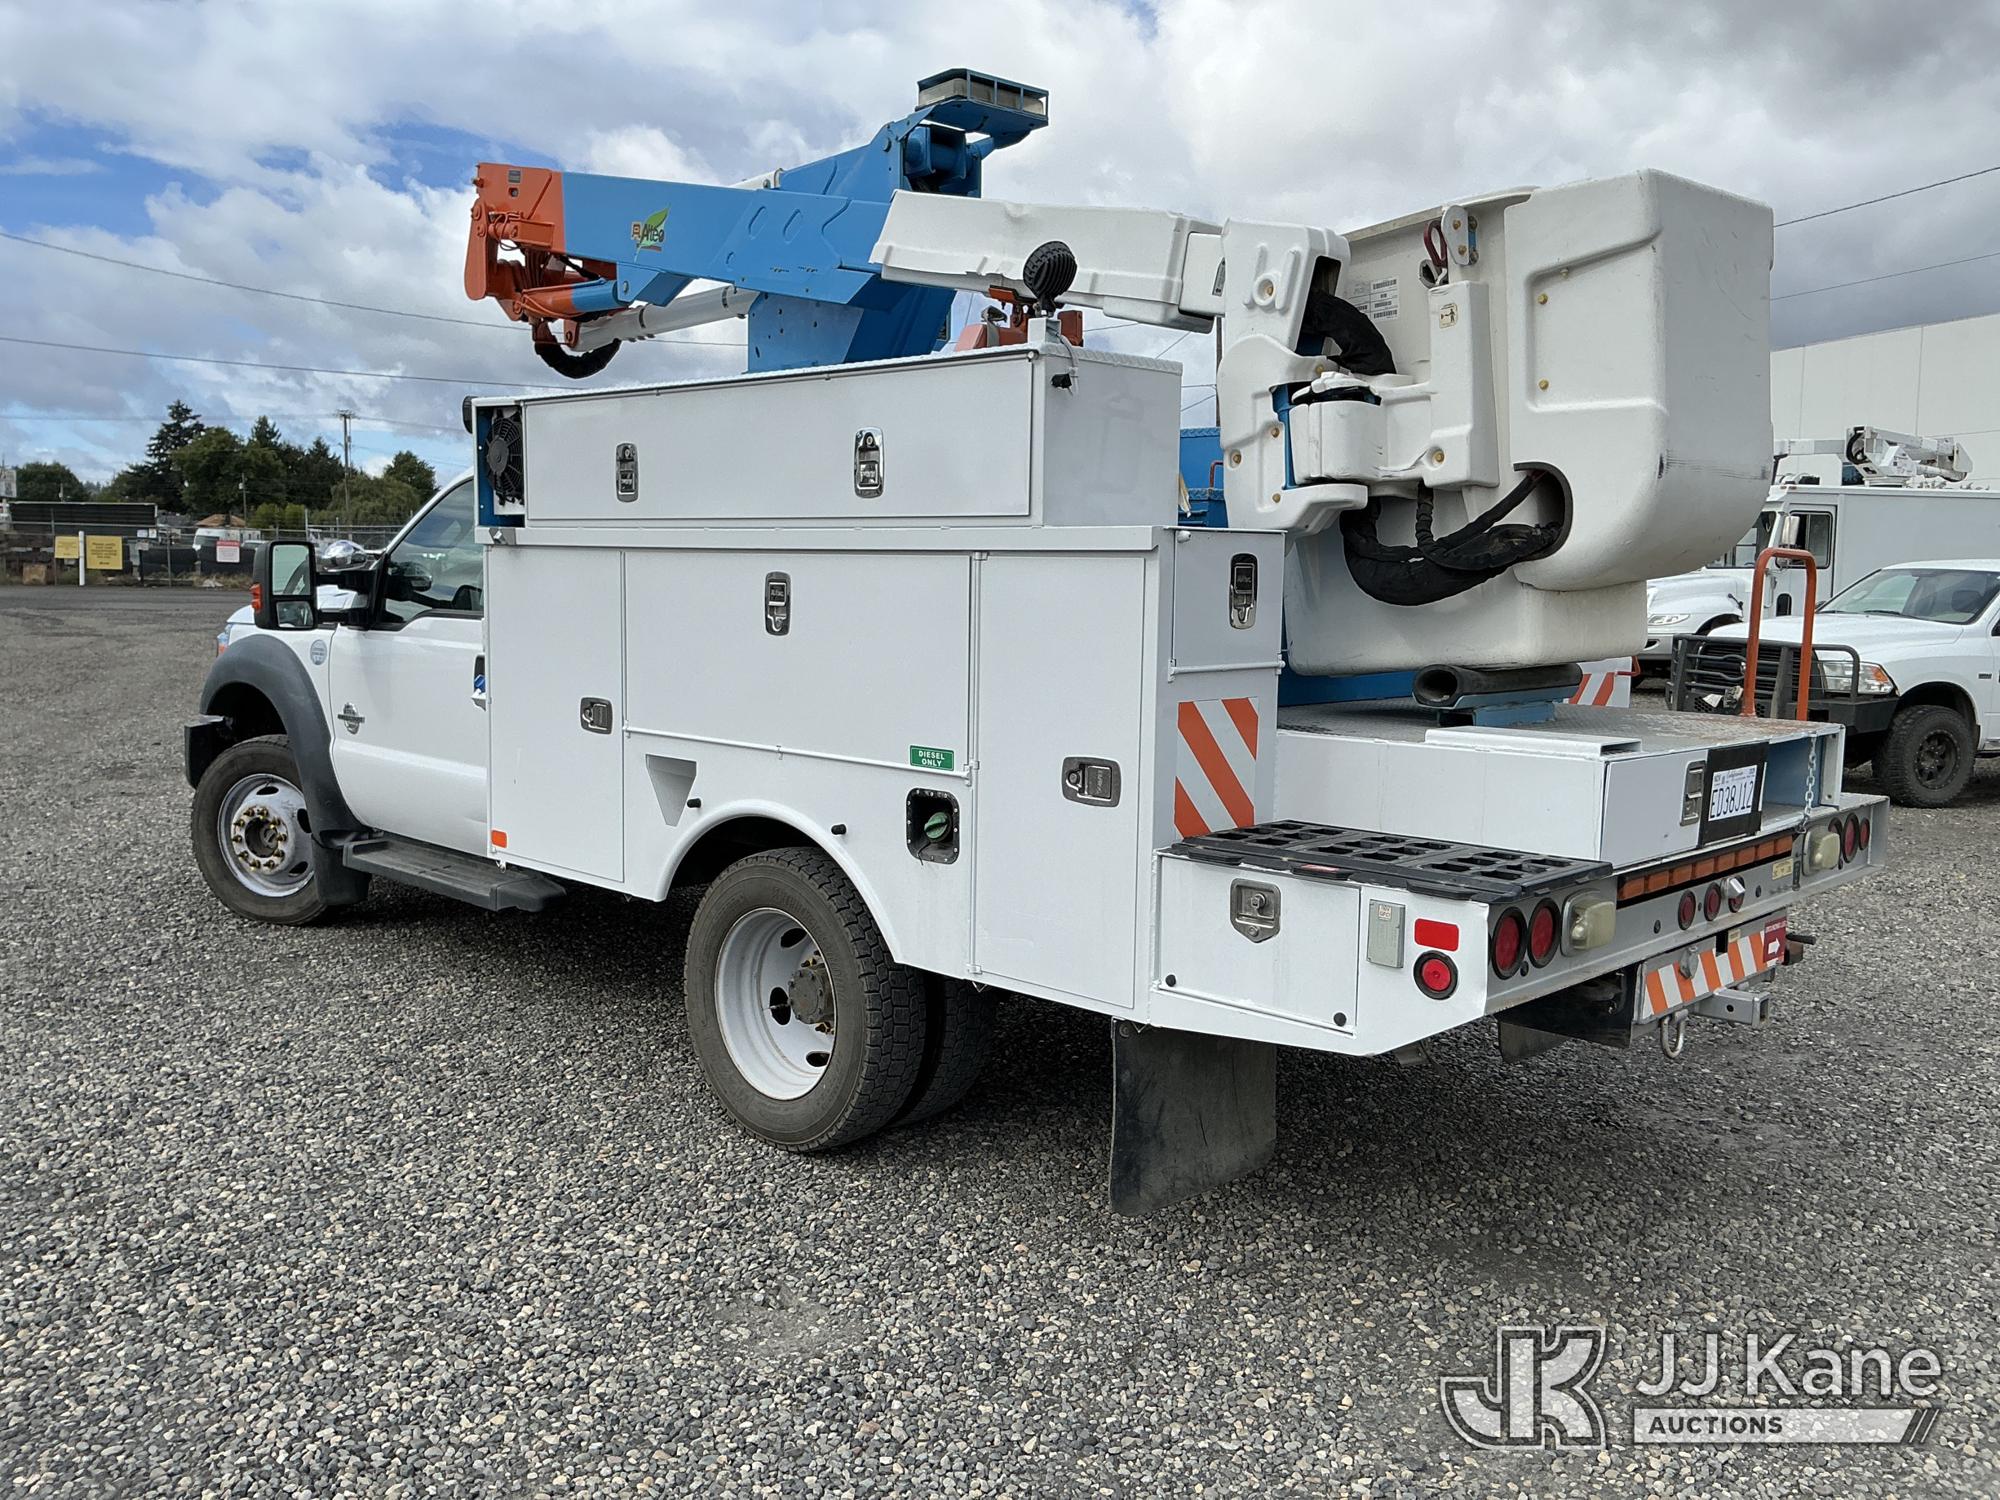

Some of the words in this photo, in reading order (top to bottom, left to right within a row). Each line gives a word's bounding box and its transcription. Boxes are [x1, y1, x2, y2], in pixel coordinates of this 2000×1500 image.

[918, 750, 945, 760] DIESEL
[921, 758, 942, 767] ONLY
[1710, 780, 1754, 819] ED38J12
